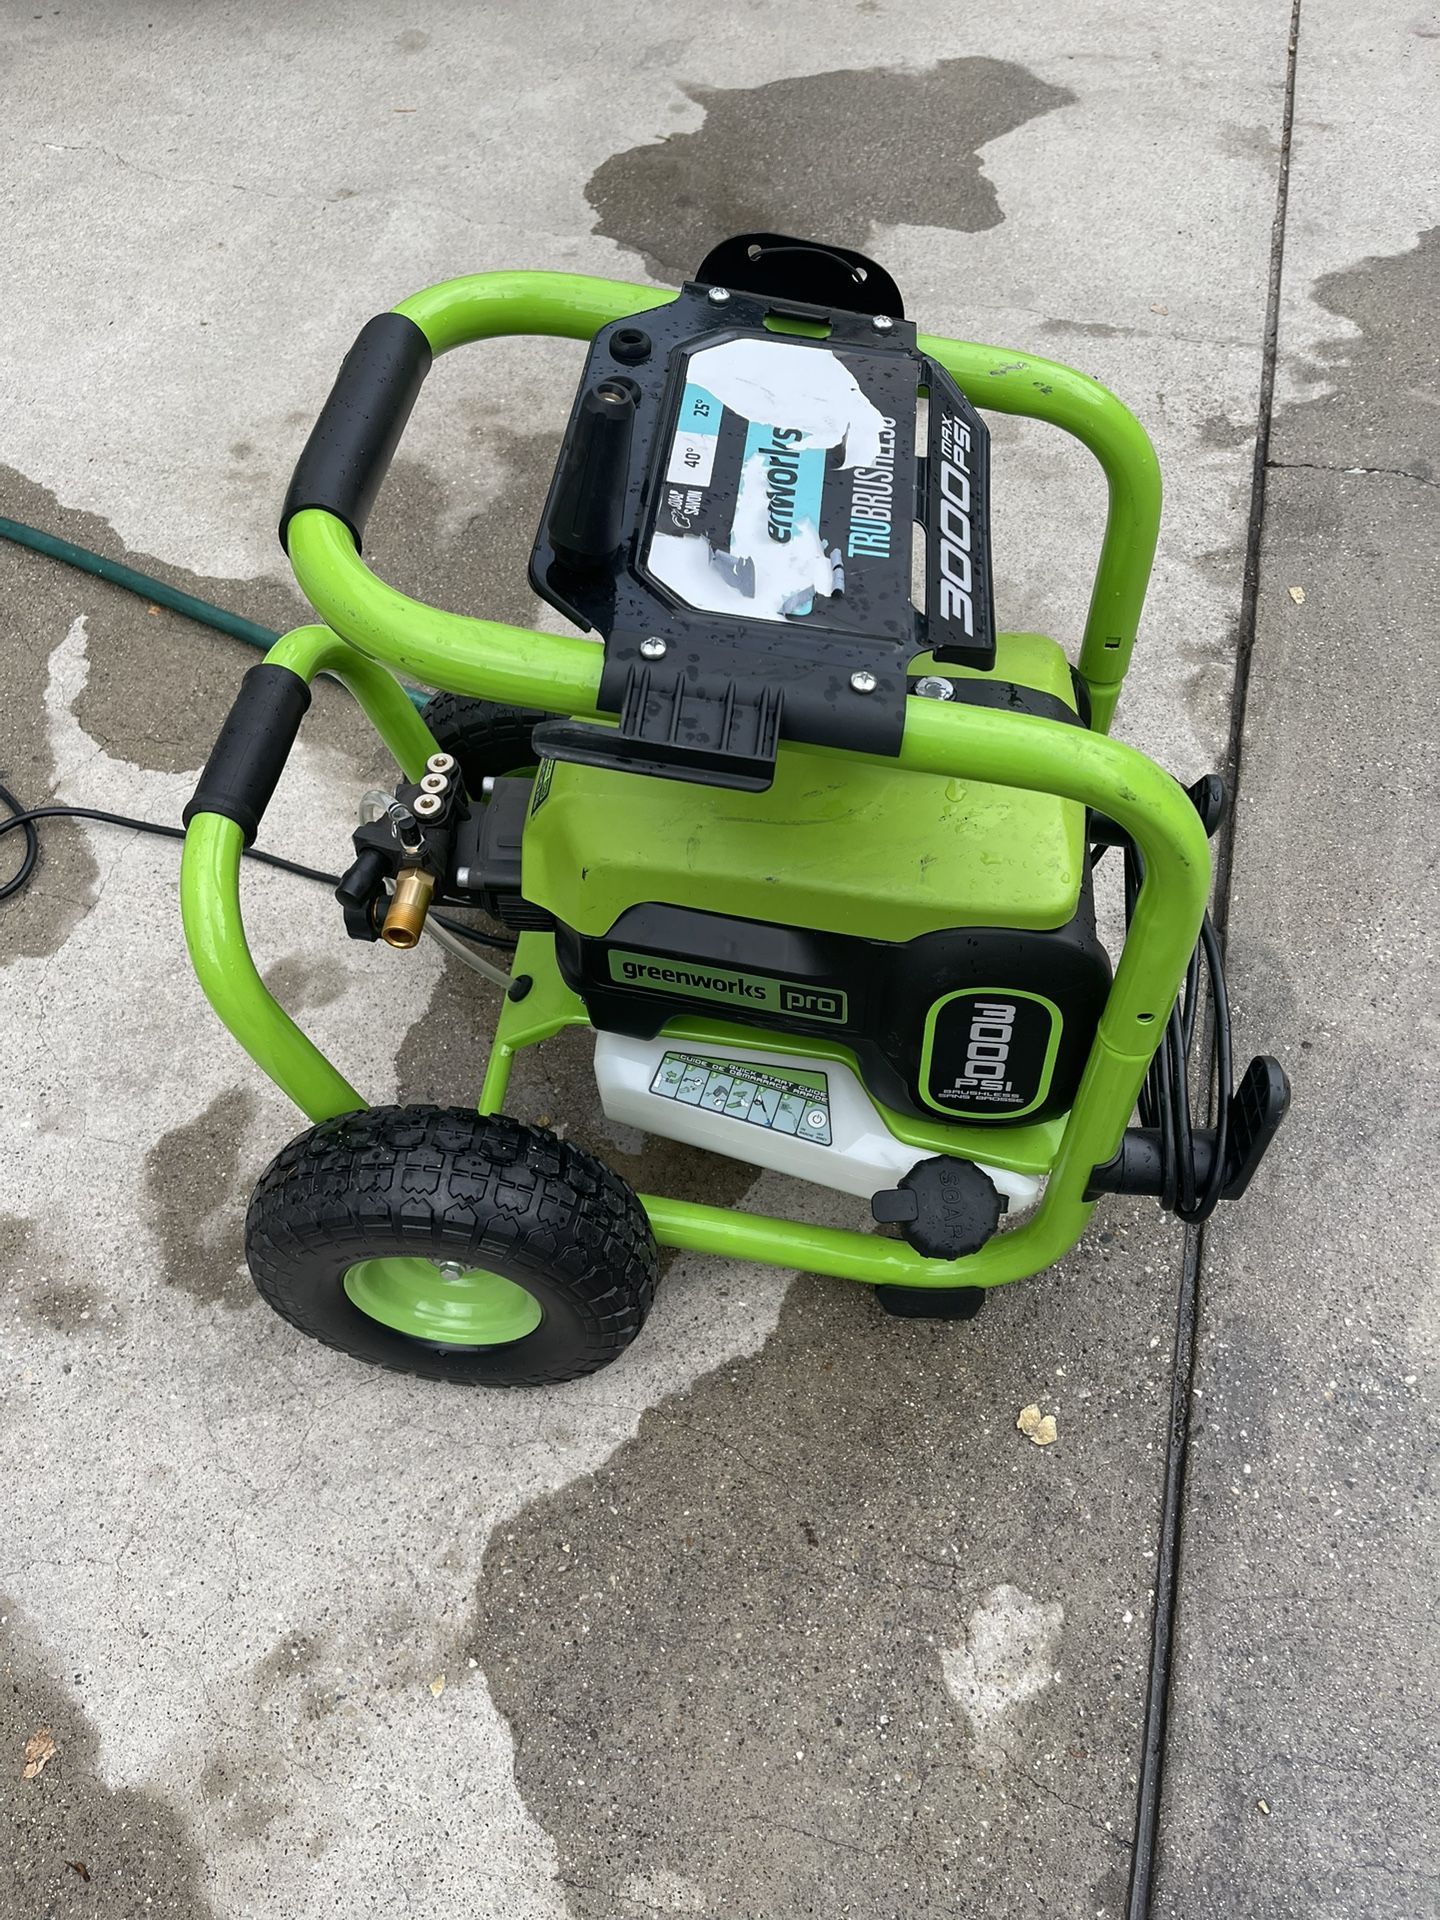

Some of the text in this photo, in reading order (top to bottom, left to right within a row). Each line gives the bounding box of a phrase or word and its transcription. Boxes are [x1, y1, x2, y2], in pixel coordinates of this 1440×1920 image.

[693, 399, 710, 417] 25°
[941, 413, 953, 459] MAX
[684, 447, 701, 469] 40°
[668, 489, 684, 511] SOAP
[684, 490, 703, 516] SAVON
[940, 416, 974, 637] 3000 PSI
[622, 961, 836, 1013] greenworks pro
[964, 1002, 1017, 1080] 3000
[680, 1054, 708, 1067] GUIDE
[711, 1064, 726, 1072] DE
[792, 1088, 829, 1104] RAPIDE
[729, 1064, 828, 1098] QUICK START GUIDE
[943, 1089, 1020, 1099] BRUSHLESS
[954, 1078, 1013, 1092] PSI
[940, 1169, 964, 1240] SOAP
